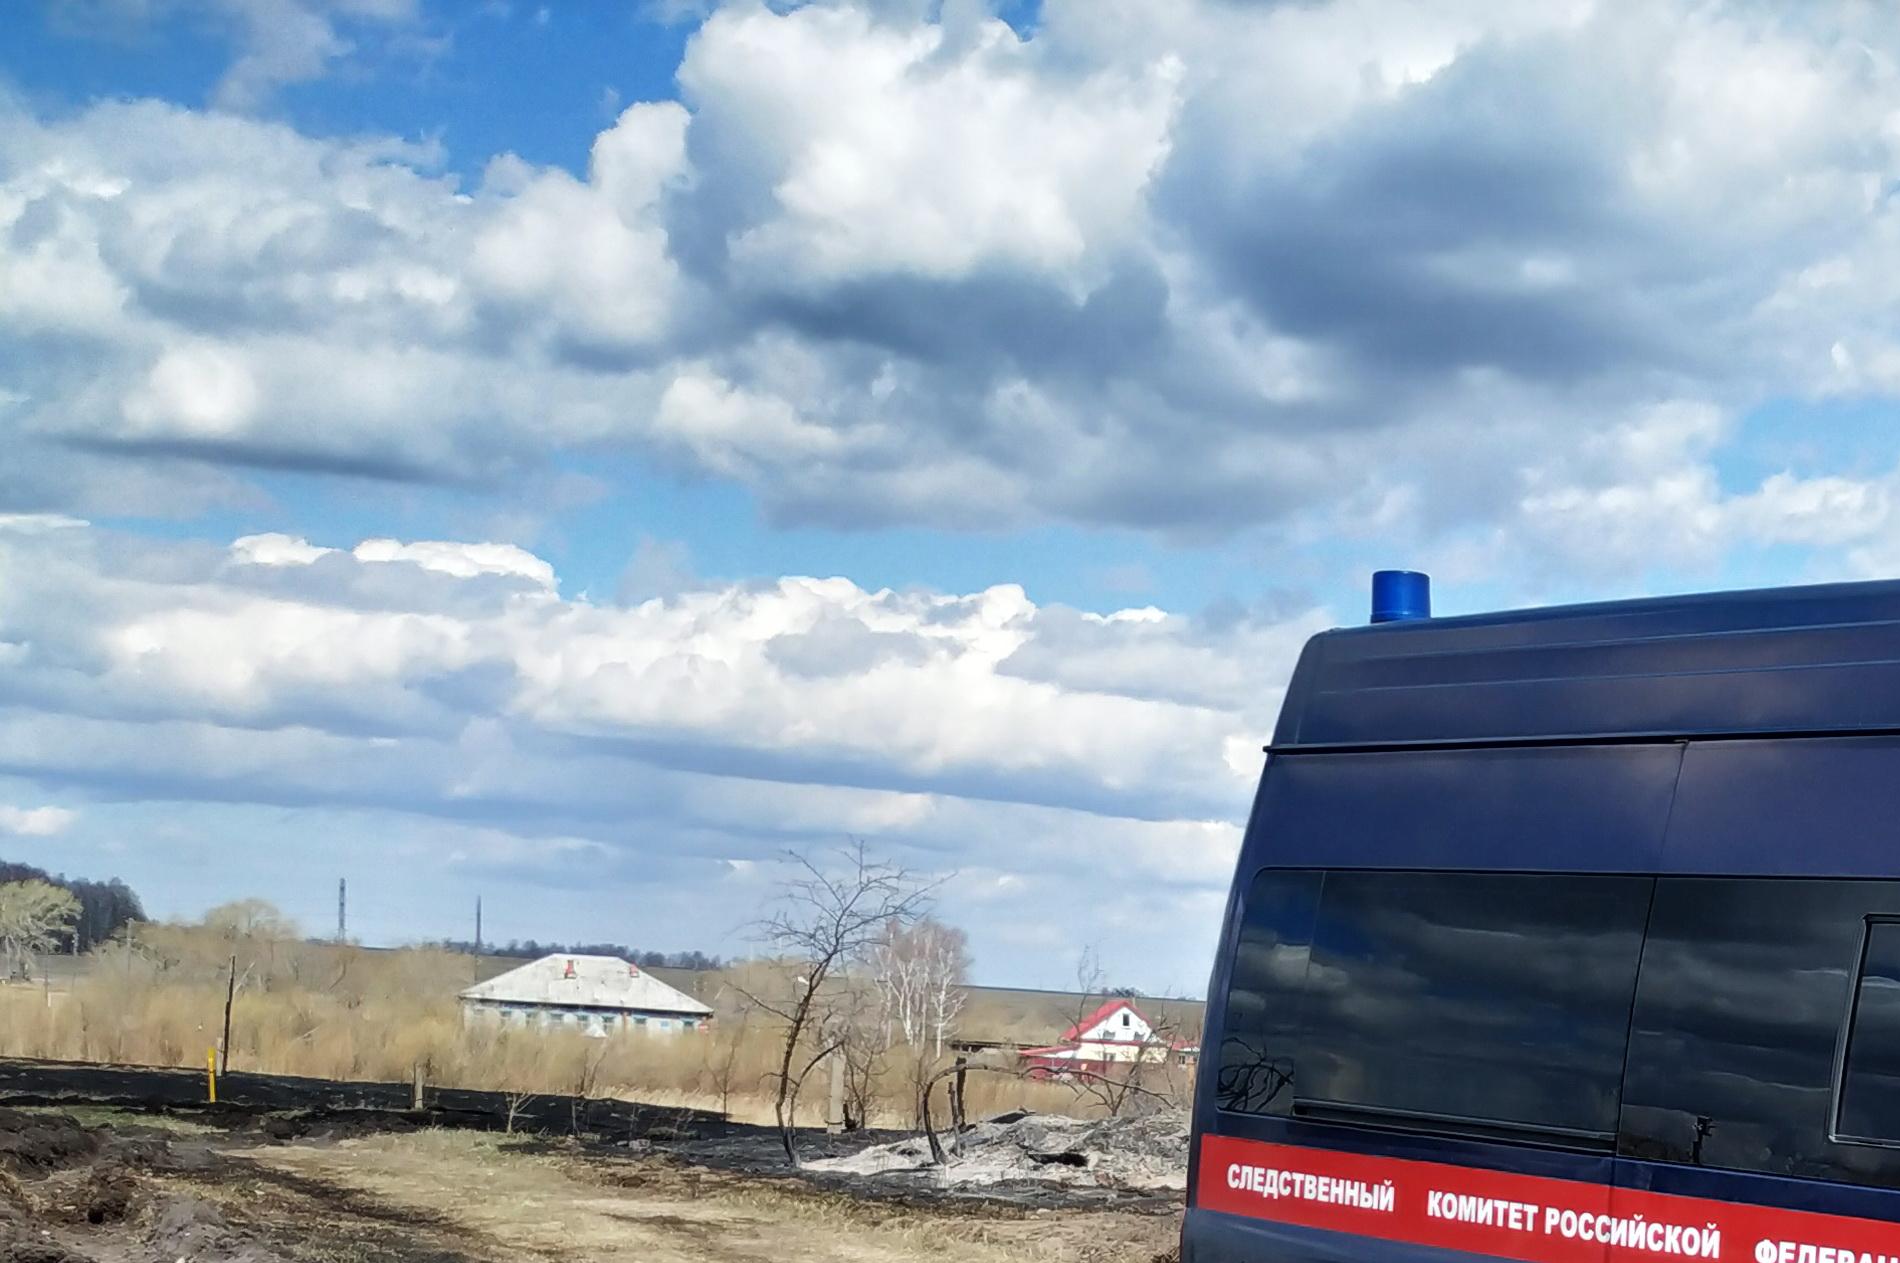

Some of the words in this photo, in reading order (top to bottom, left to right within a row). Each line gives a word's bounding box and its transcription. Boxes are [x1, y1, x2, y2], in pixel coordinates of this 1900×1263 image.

[1227, 1163, 1395, 1212] СЛЕДСТВЕННЫЙ
[1427, 1190, 1538, 1232] КОМИТЕТ
[1544, 1207, 1721, 1259] РОССИЙСКОЙ
